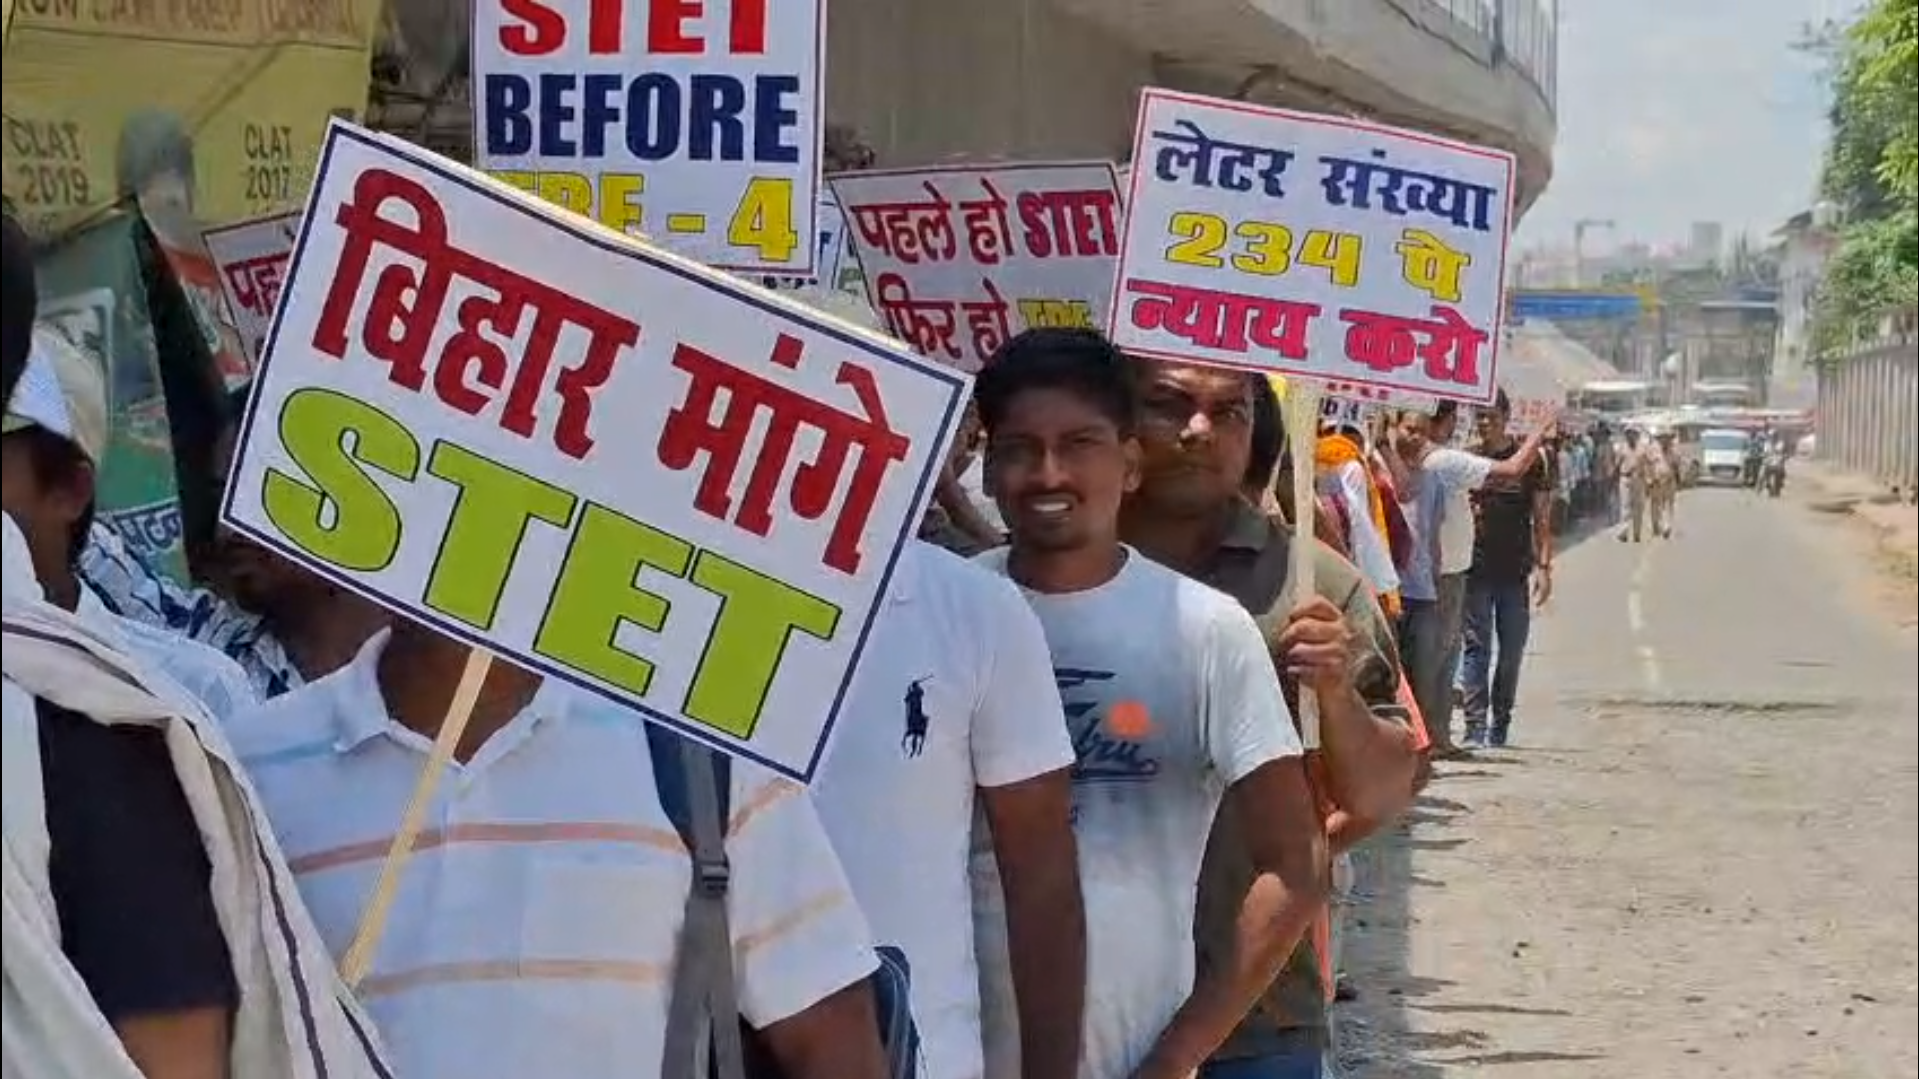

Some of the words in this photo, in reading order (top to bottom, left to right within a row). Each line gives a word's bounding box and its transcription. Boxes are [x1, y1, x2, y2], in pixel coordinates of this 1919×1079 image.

[9, 119, 81, 160] CLAT
[244, 123, 292, 160] CLAT
[485, 72, 800, 163] BEFORE
[18, 162, 89, 206] 2019
[244, 164, 291, 200] 2017
[727, 176, 798, 262] 4
[849, 180, 957, 264] पहले
[959, 177, 1015, 265] हो
[1016, 189, 1120, 258] STET
[1153, 120, 1294, 198] लेटर
[1319, 148, 1498, 231] संख्या
[1165, 211, 1363, 288] 234
[1395, 228, 1471, 302] पे
[876, 272, 963, 359] फिर
[961, 277, 1012, 366] हो
[1127, 278, 1321, 361] न्याय
[1339, 305, 1490, 386] करो
[311, 168, 641, 460] बिहार
[657, 333, 911, 575] मांगे
[261, 387, 842, 741] STET
